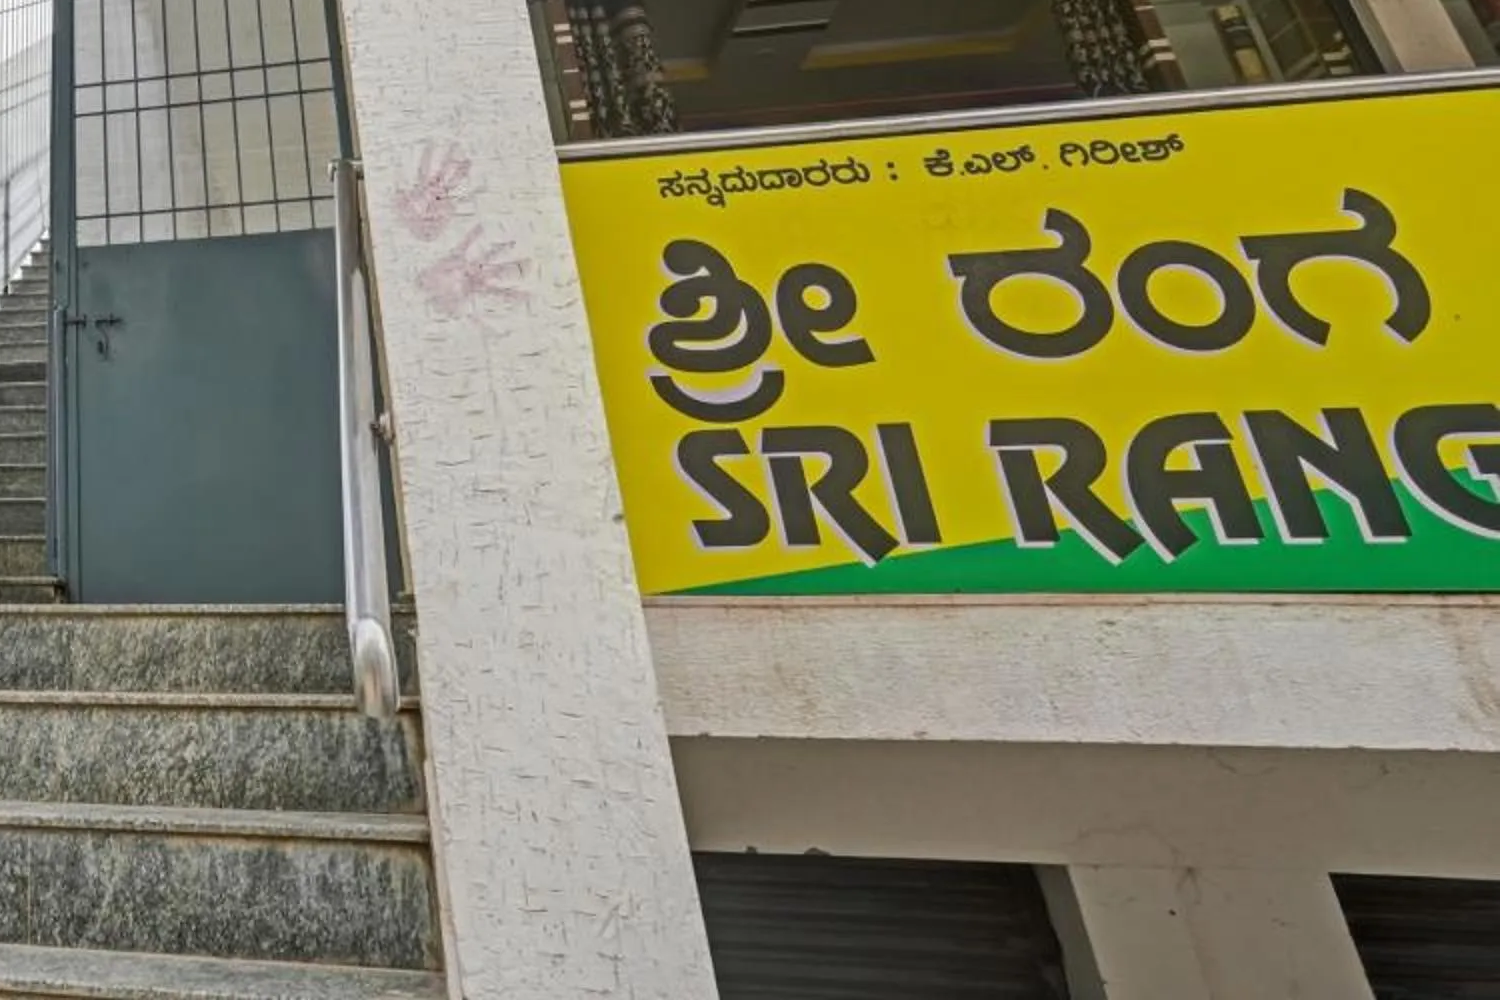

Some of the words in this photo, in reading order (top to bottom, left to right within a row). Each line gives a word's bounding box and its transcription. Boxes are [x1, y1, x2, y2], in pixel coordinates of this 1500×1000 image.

[657, 156, 871, 208] ಸನ್ನದುದಾರರು
[1059, 133, 1186, 168] ಗಿರೀಶ್
[648, 238, 877, 424] ಶ್ರೀ
[947, 187, 1432, 360] ರಂಗ
[674, 421, 942, 566] SRI
[988, 403, 1500, 564] RANG
